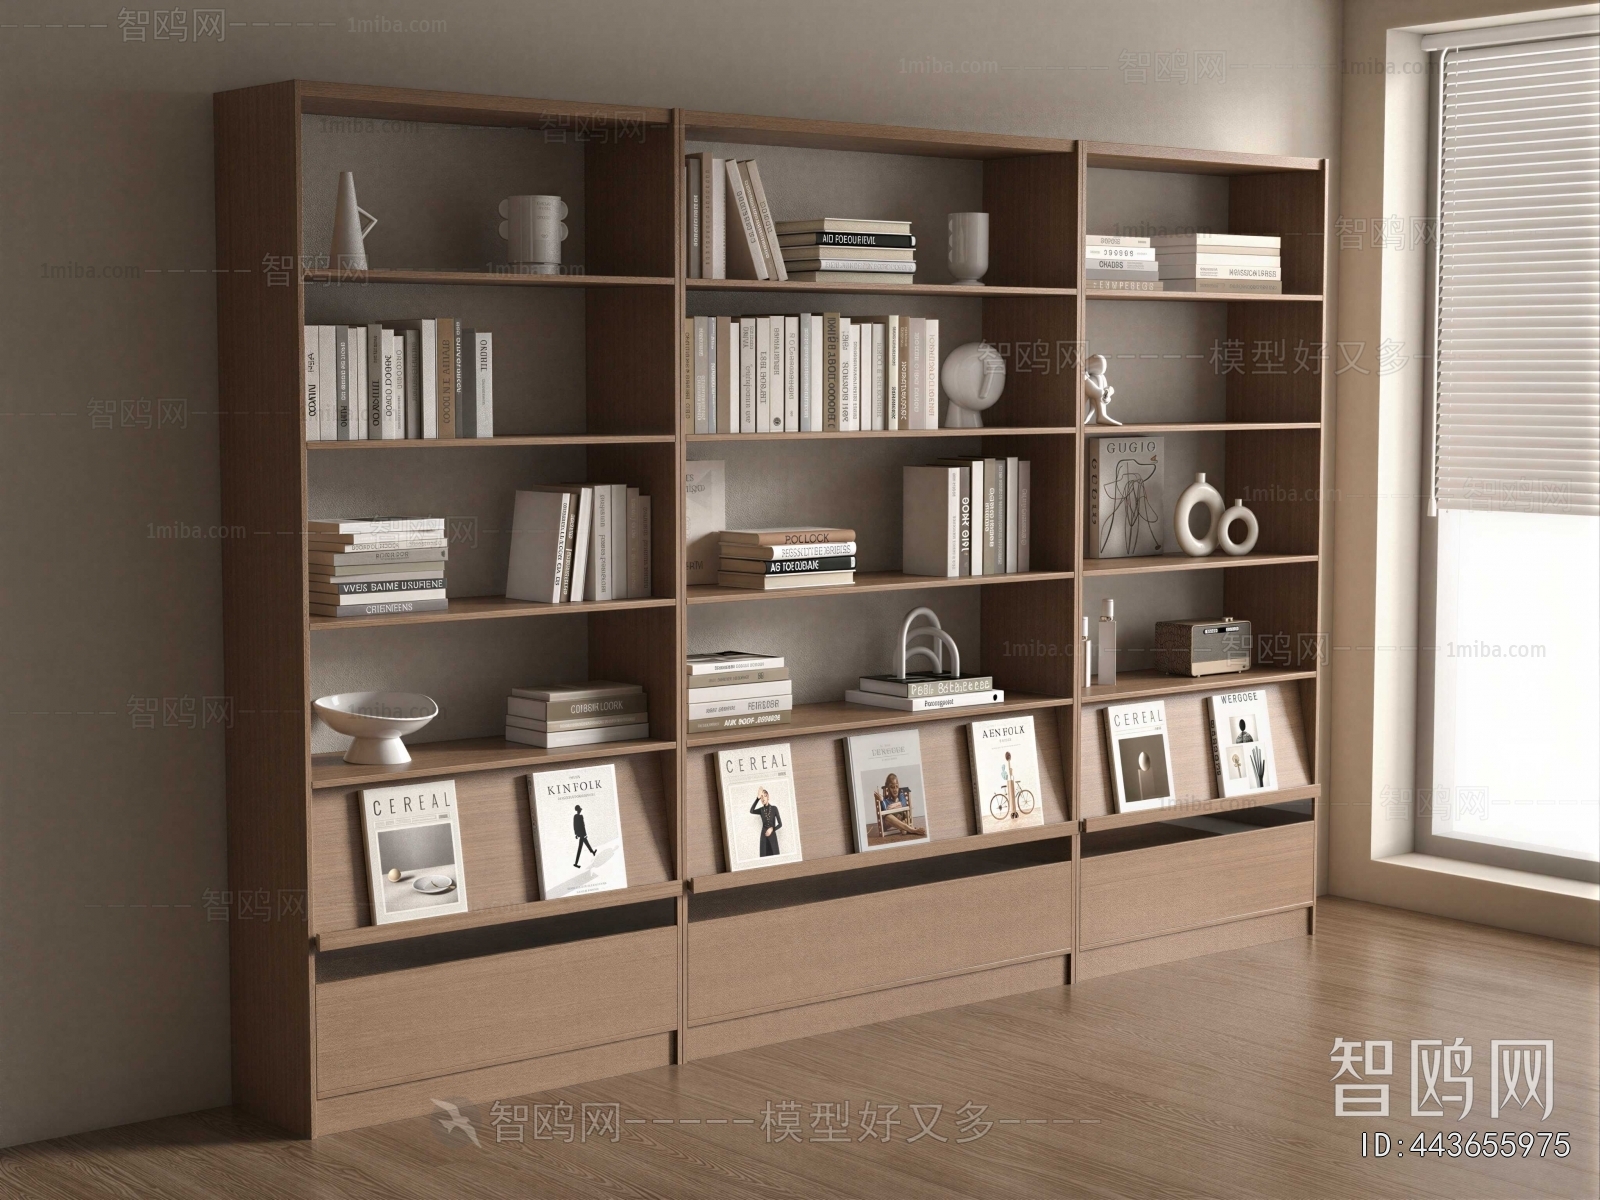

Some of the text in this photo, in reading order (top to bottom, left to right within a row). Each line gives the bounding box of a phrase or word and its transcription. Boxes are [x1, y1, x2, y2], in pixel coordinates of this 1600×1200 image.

[1113, 709, 1164, 727] CEREAL
[726, 753, 787, 774] CEREAL
[547, 779, 603, 796] KINFOLK
[373, 792, 451, 817] CEREAL
